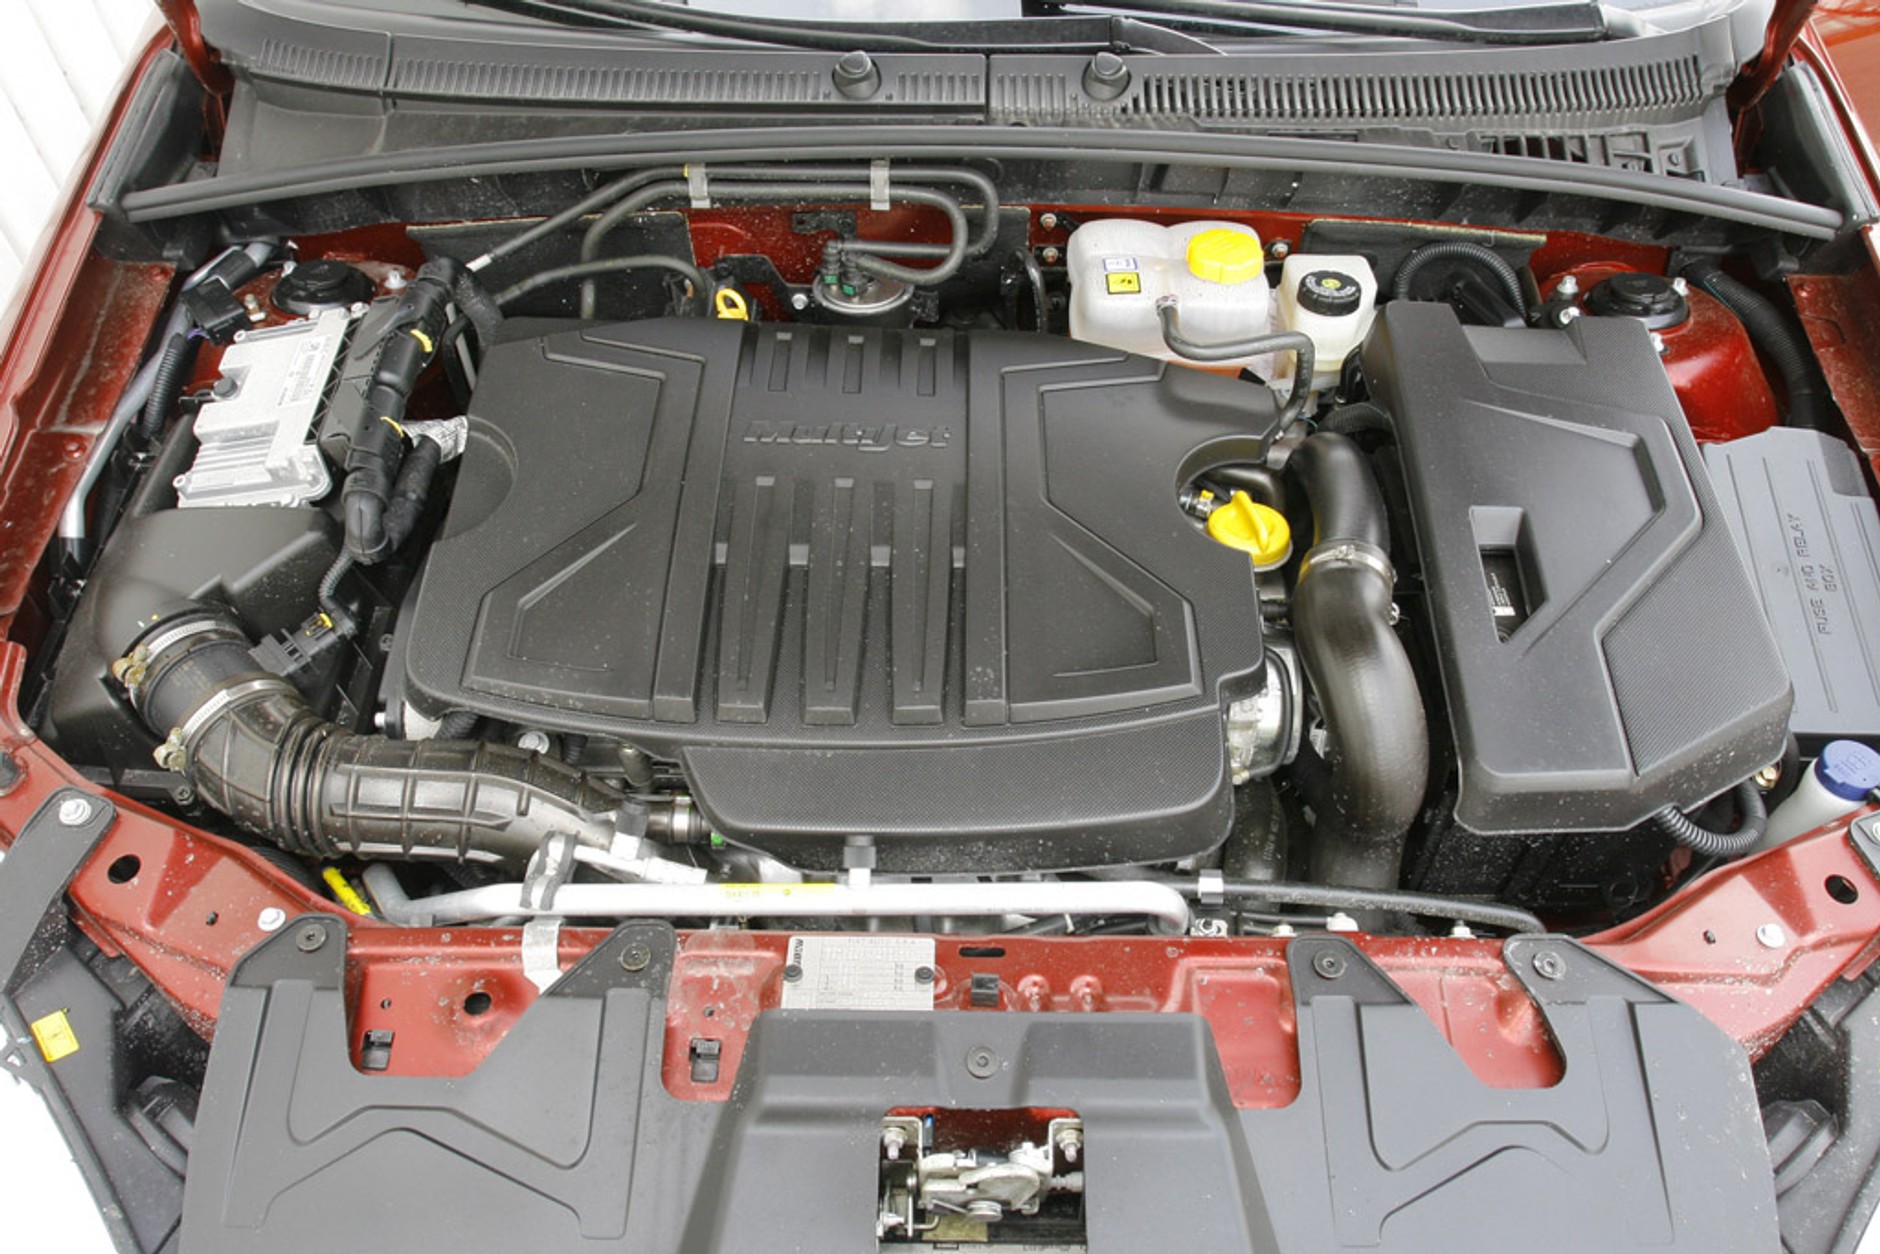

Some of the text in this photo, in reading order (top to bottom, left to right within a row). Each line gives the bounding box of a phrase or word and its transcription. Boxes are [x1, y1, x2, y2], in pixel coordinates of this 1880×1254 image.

[1787, 513, 1831, 635] FUSE AND RELAY
[1819, 564, 1837, 592] BOX
